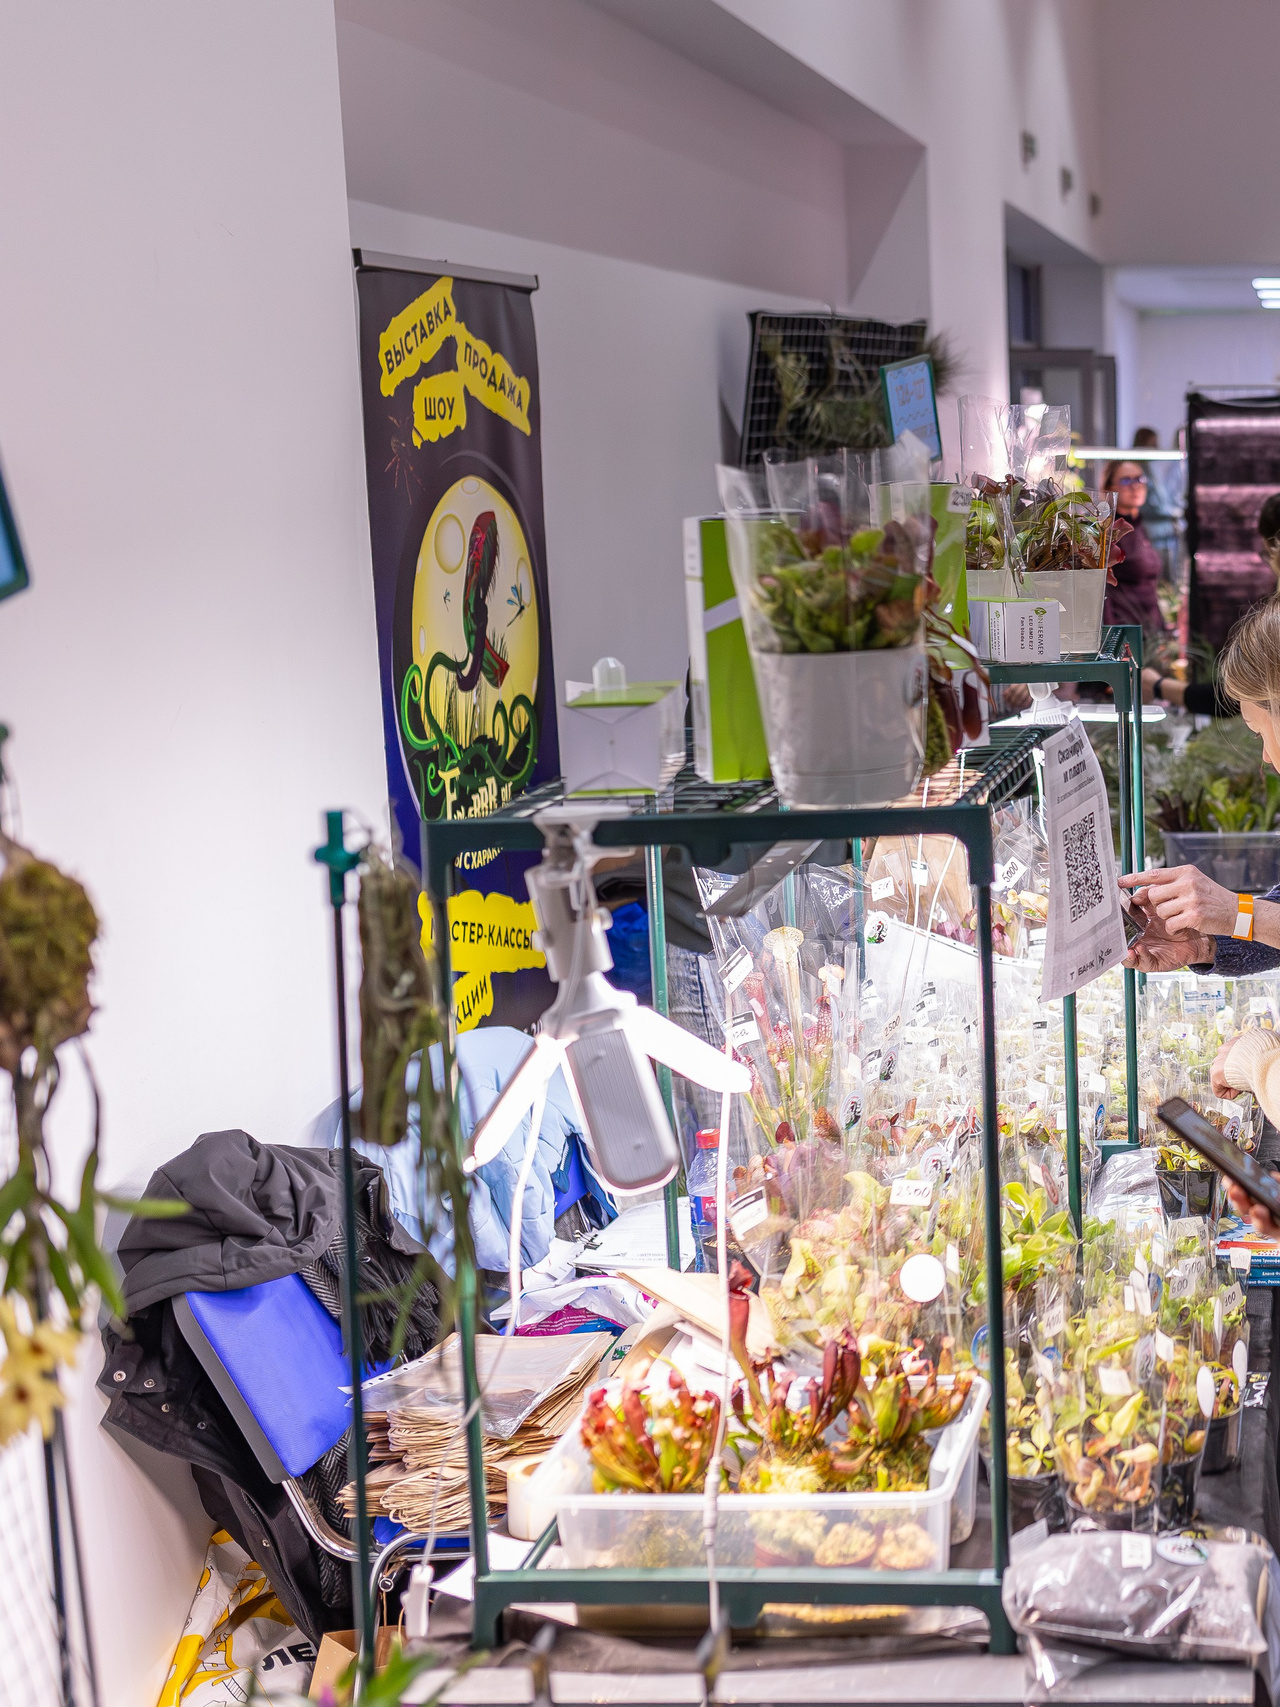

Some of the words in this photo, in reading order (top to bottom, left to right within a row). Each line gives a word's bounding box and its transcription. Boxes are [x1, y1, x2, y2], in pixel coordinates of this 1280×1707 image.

[384, 297, 452, 375] ВЫСТАВКА
[464, 341, 523, 412] ПРОДАЖА
[424, 397, 455, 420] ШОУ
[471, 846, 504, 870] ХАРАК
[430, 917, 534, 951] СТЕР-КЛАССЫ
[455, 975, 488, 1024] КЦИИ
[1171, 1279, 1188, 1293] 600
